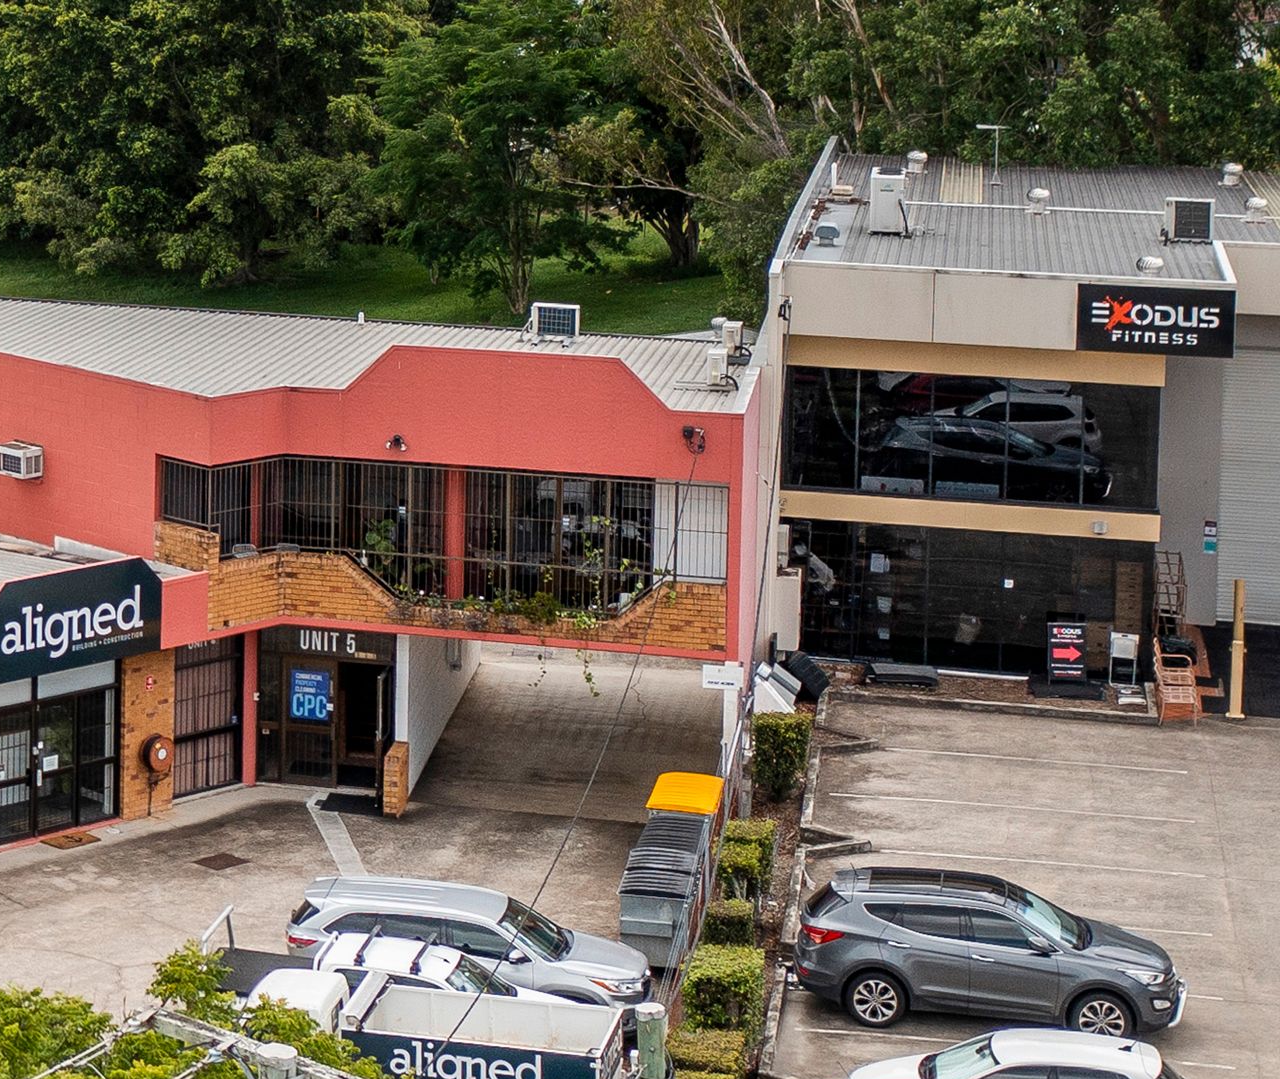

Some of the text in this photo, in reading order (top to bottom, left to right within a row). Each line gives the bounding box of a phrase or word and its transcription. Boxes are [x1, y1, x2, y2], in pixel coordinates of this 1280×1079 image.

[1091, 297, 1220, 329] EXODUS
[0, 584, 144, 658] aligned
[300, 629, 356, 654] UNIT 5
[292, 693, 328, 718] CPC
